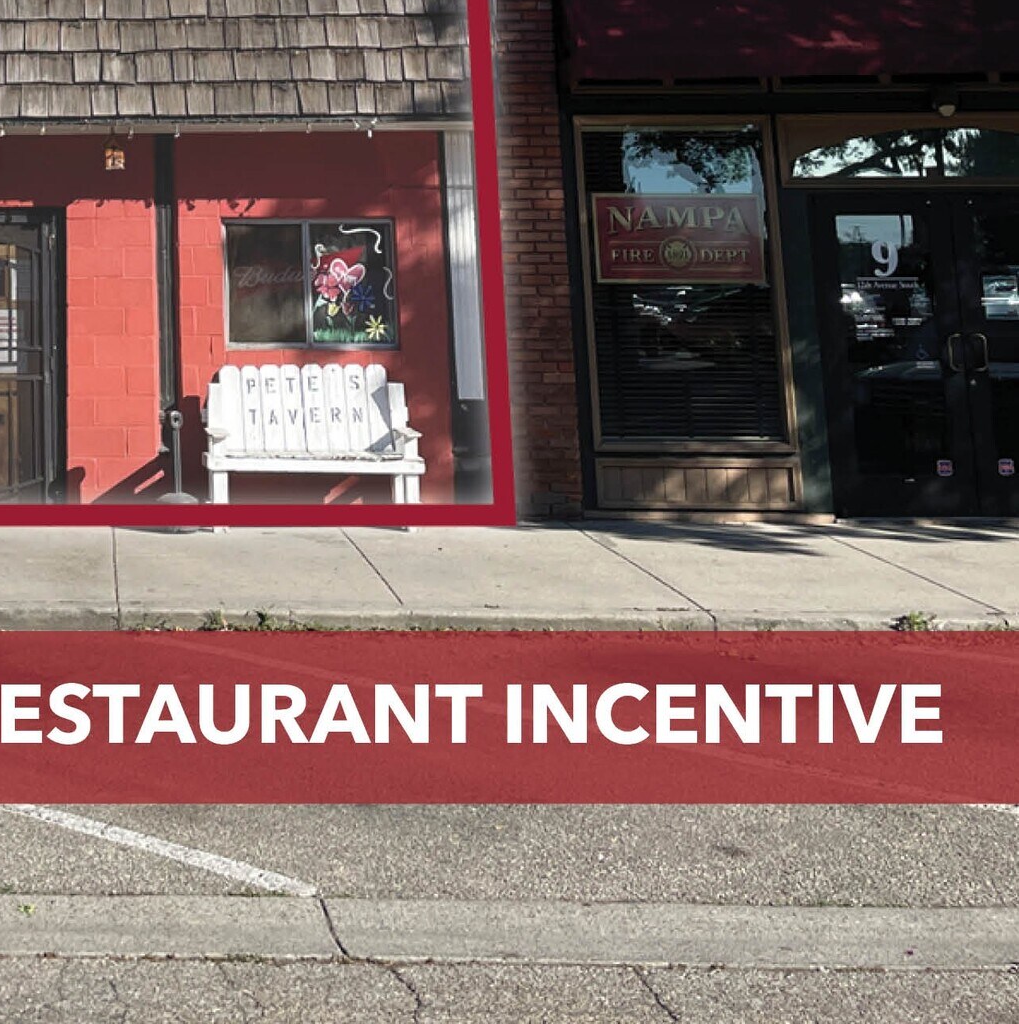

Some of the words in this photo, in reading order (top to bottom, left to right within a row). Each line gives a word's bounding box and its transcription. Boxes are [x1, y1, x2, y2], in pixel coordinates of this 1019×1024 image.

[606, 205, 750, 235] NAMPA
[611, 248, 655, 262] FIRE
[701, 248, 749, 263] DEPT
[871, 240, 898, 276] 9
[248, 406, 363, 426] TAVERN
